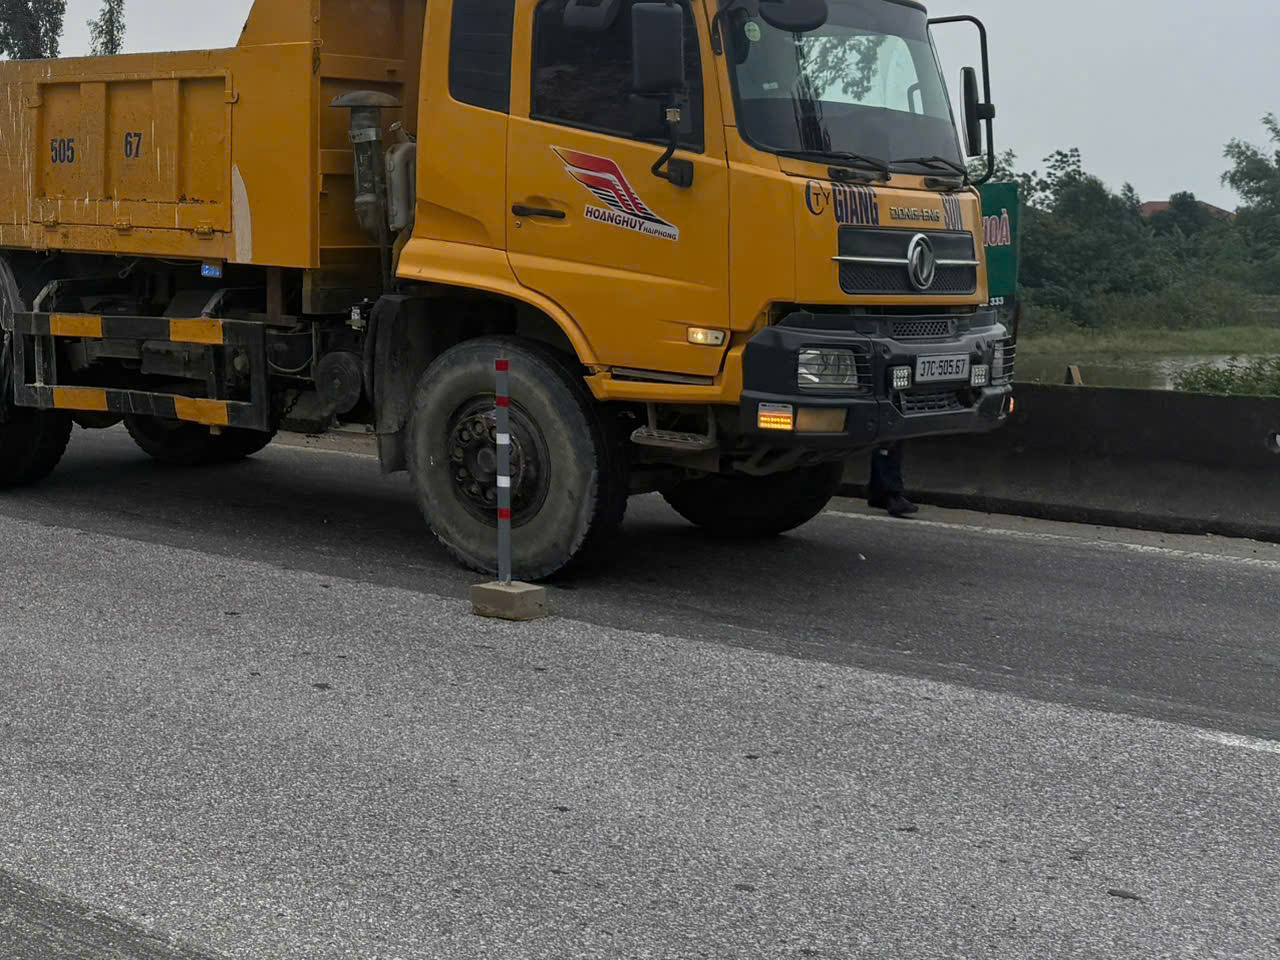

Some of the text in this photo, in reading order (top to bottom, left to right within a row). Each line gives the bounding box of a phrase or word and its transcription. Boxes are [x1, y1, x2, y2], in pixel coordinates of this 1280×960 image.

[50, 138, 75, 164] 505
[123, 131, 142, 159] 67
[830, 182, 880, 226] GIANG
[643, 226, 677, 240] HAIPHONG
[920, 358, 966, 377] 37C-505.67
